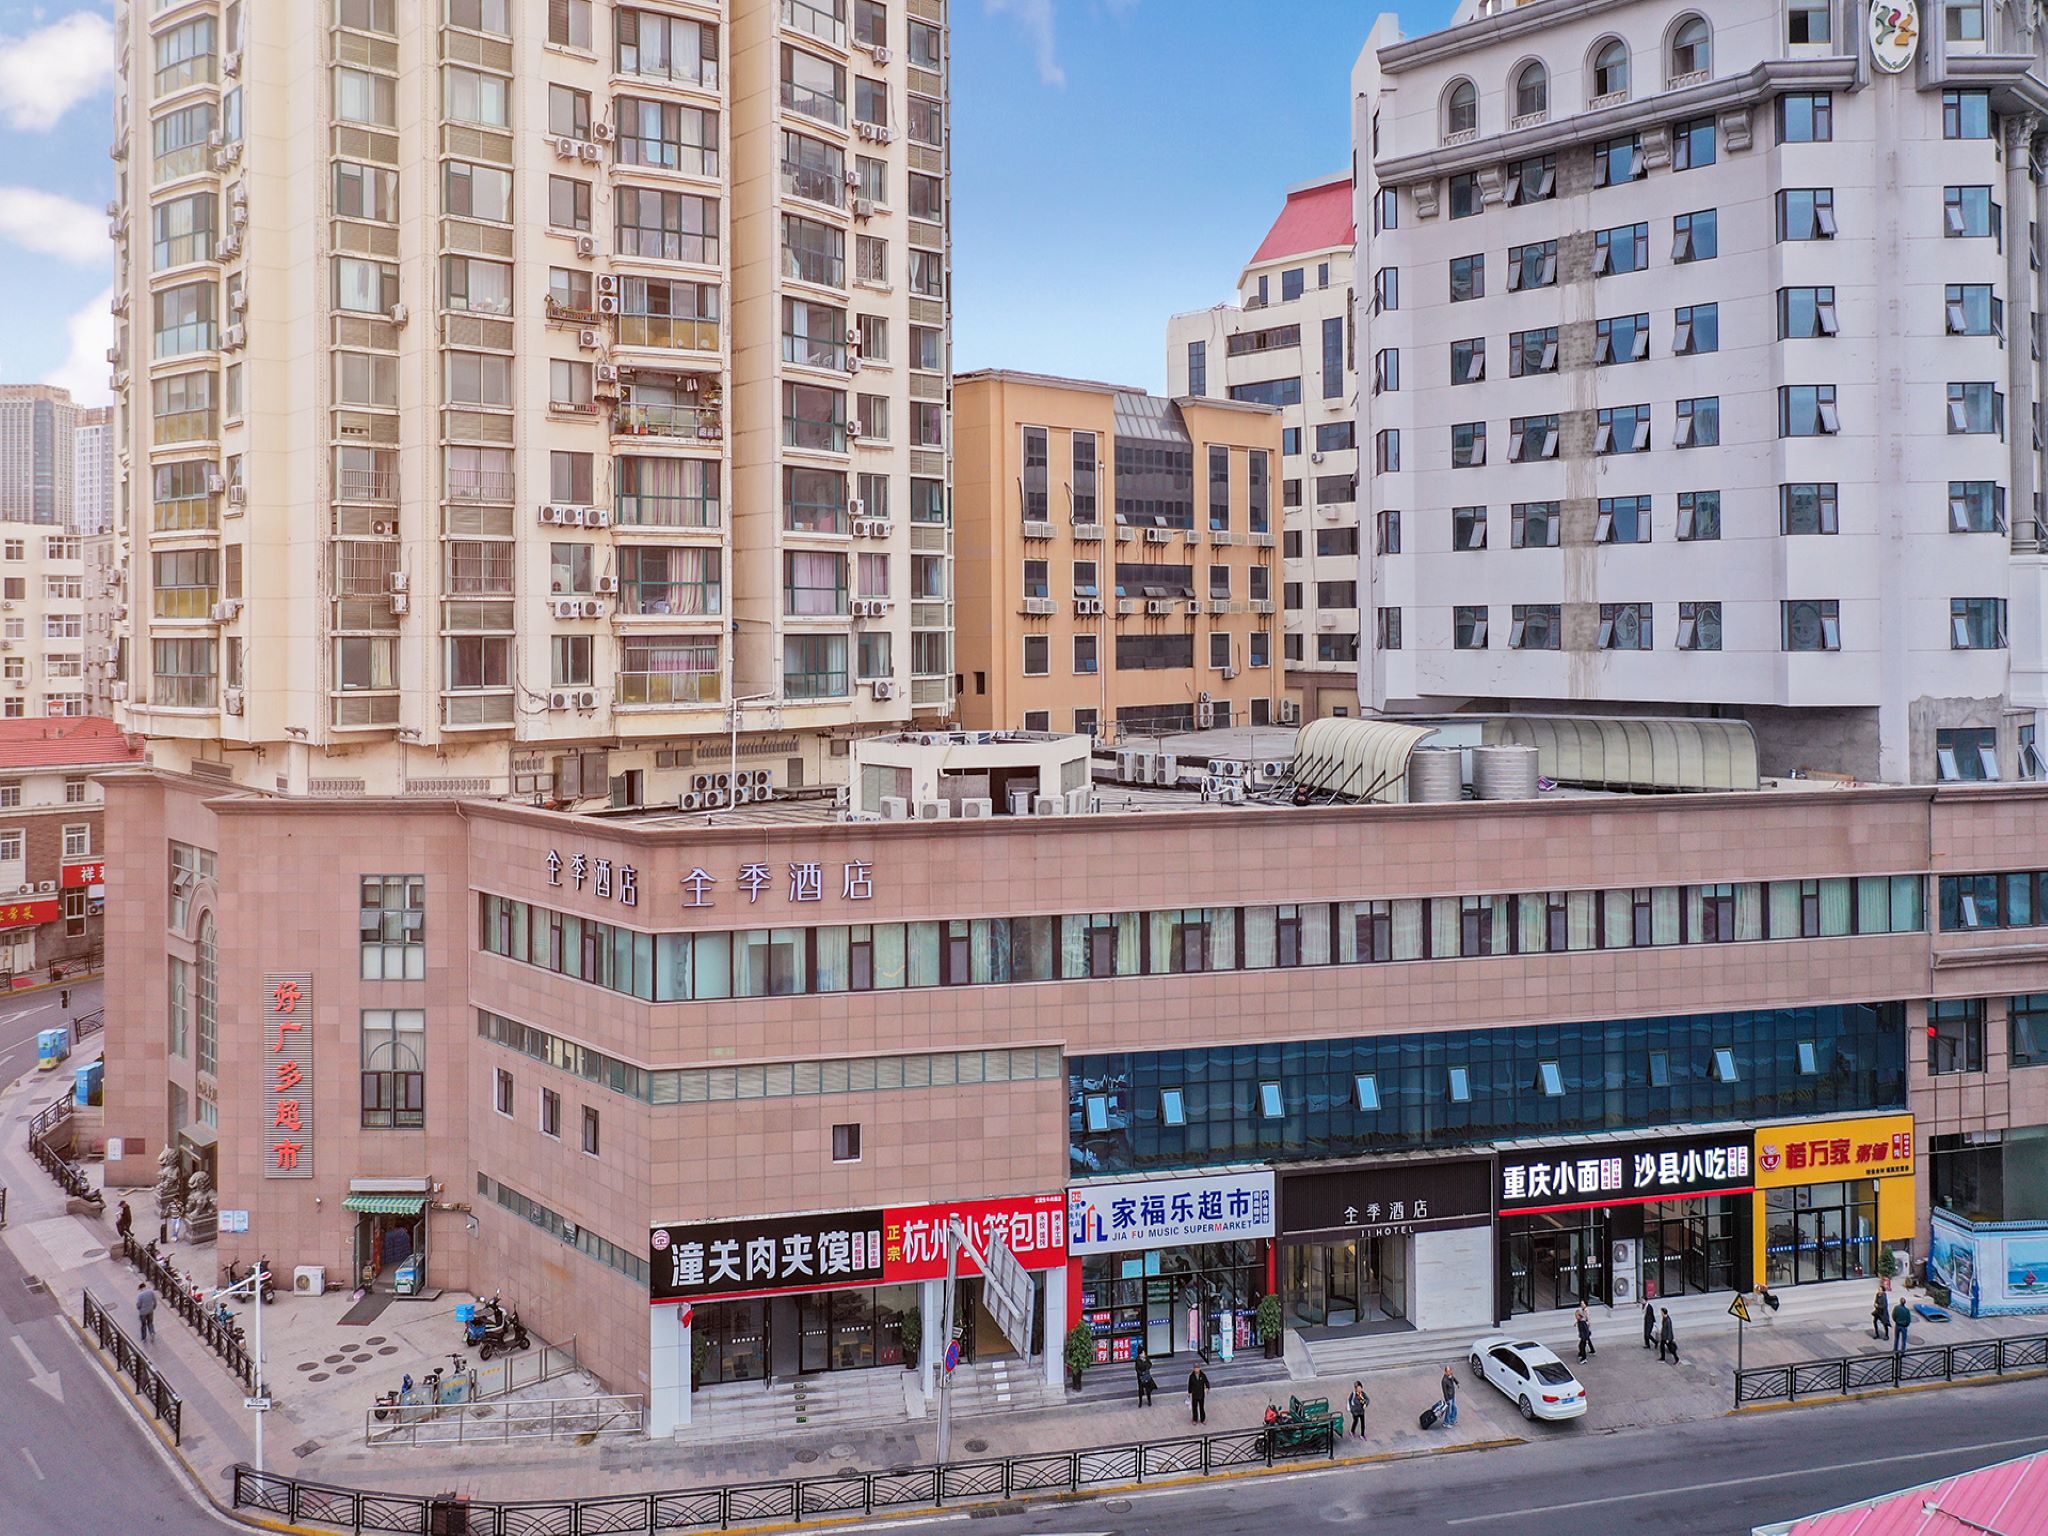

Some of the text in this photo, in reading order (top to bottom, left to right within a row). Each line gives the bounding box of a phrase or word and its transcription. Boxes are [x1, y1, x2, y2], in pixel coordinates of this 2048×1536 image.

[545, 849, 638, 907] 全季酒店
[680, 857, 873, 908] 全季酒店
[273, 980, 304, 1170] 好广多超市
[1503, 1158, 1600, 1199] 重庆小面
[1633, 1147, 1727, 1188] 沙县小吃
[1112, 1188, 1251, 1229] 家福乐超市
[1343, 1199, 1428, 1225] 全季酒店
[887, 1225, 900, 1262] 正宗
[1112, 1219, 1252, 1241] JIA FU MUSIC SUPERMARKET
[1376, 1226, 1414, 1237] HOTEL
[671, 1230, 850, 1287] 潼关肉夹馍
